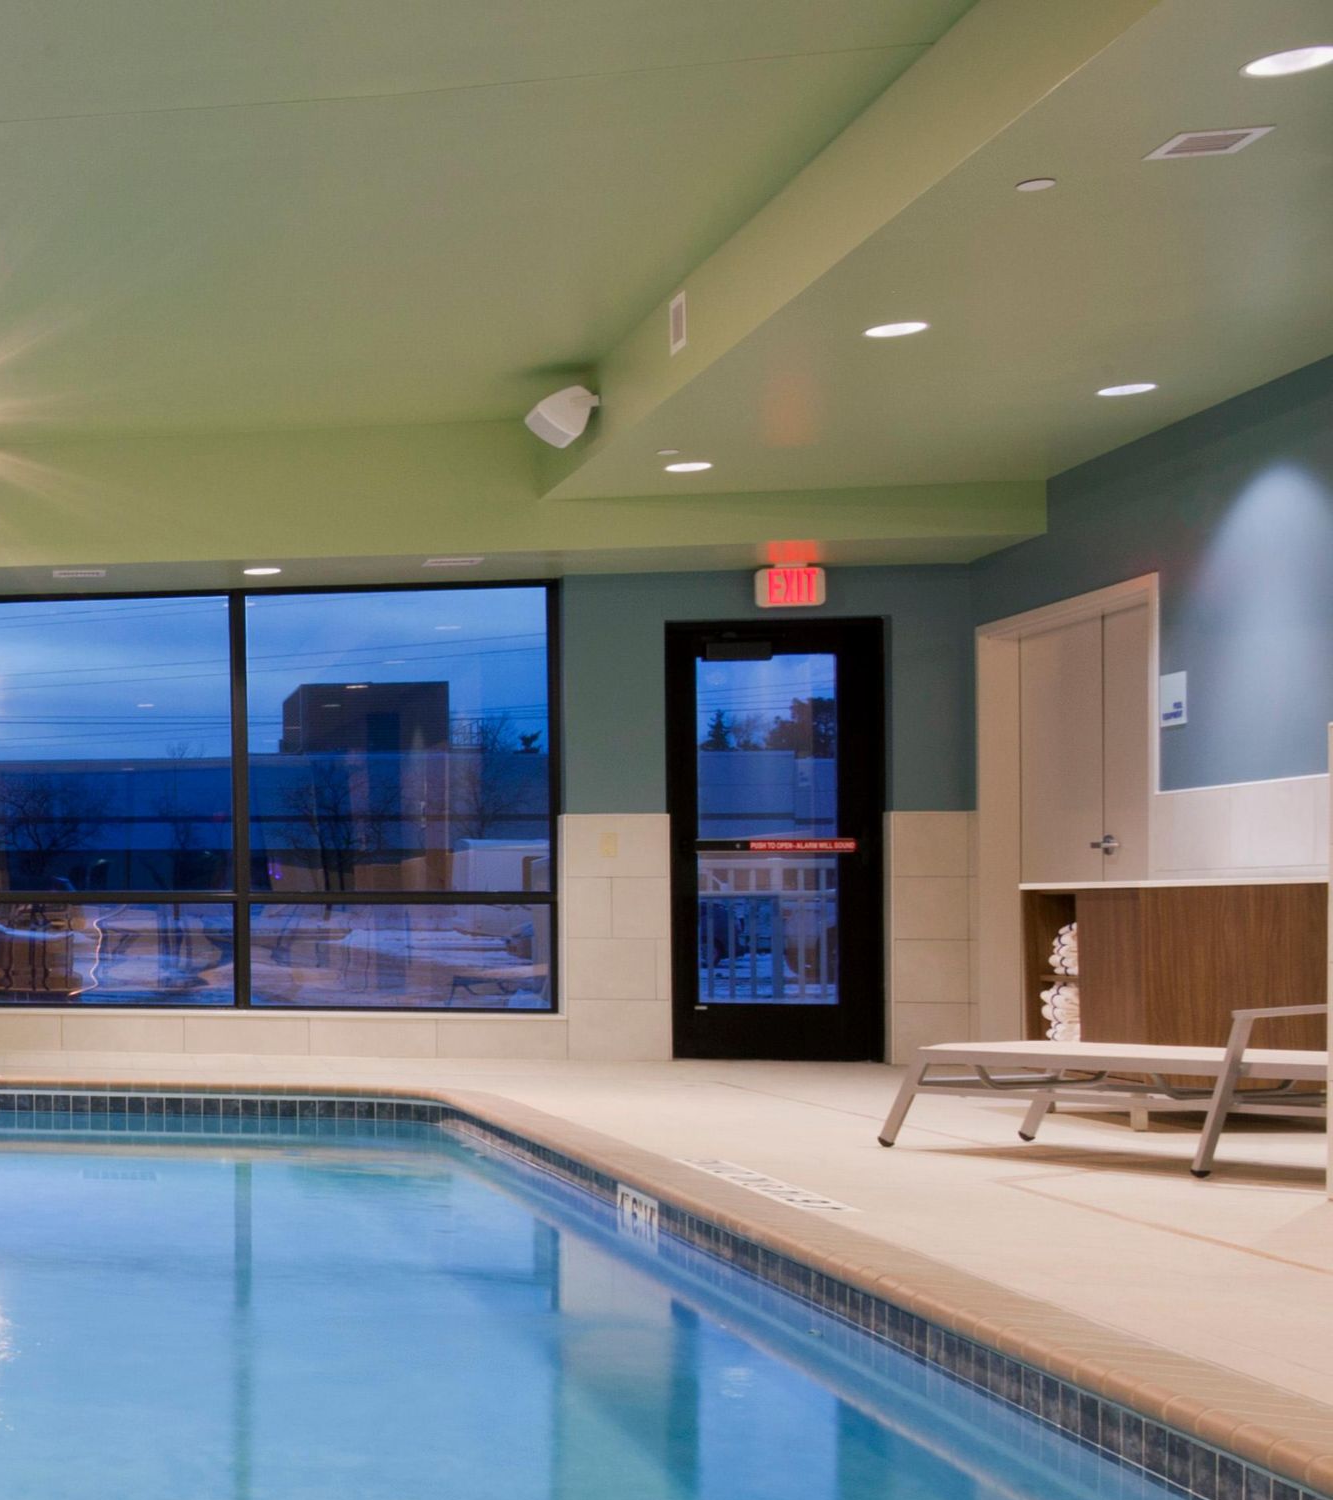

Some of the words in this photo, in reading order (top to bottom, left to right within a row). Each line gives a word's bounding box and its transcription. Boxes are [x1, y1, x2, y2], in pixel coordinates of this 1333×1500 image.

[768, 568, 817, 604] EXIT
[750, 841, 767, 849] PUSH
[767, 841, 776, 849] TO
[819, 841, 833, 849] WILL
[834, 841, 856, 849] SOUND
